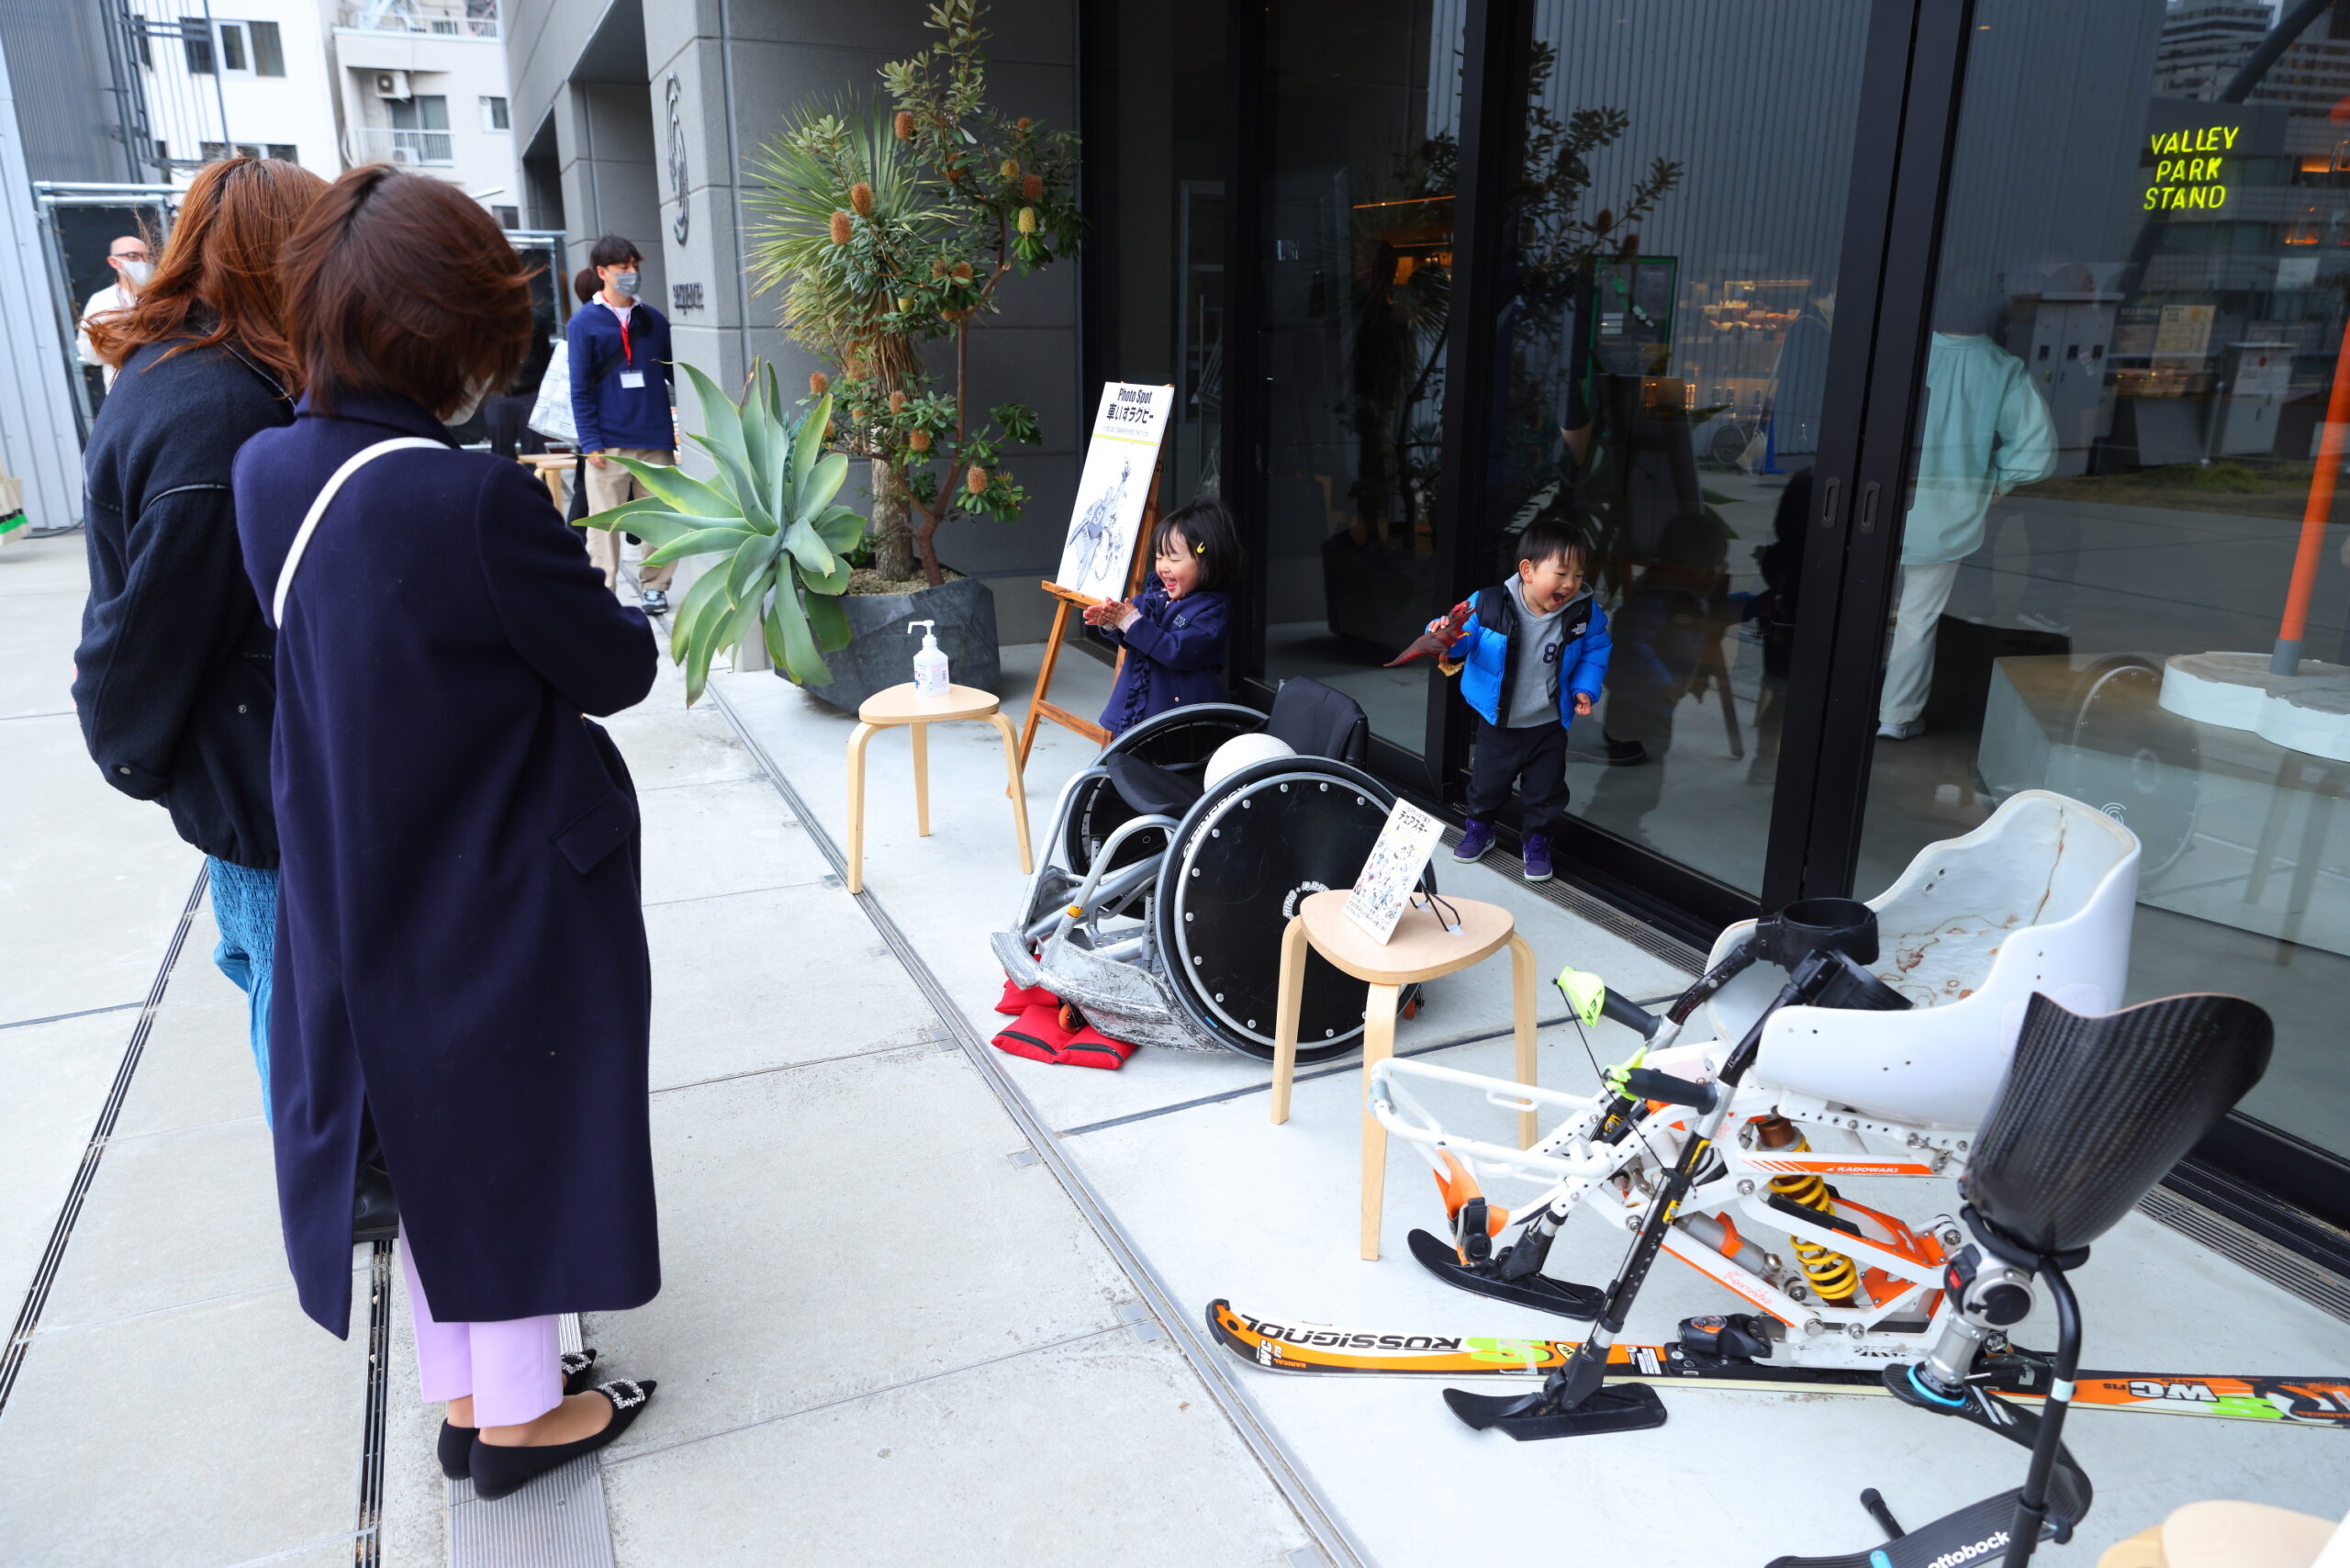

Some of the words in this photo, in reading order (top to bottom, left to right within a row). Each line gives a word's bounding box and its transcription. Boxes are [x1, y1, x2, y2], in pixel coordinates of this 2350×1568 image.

[2151, 126, 2240, 155] VALLEY
[2155, 156, 2223, 183] PARK
[2143, 185, 2227, 210] STAND
[1117, 387, 1136, 403] Photo
[1136, 389, 1153, 404] Spot
[1106, 403, 1154, 424] 車いすラグビー
[1542, 643, 1557, 664] 8
[1398, 810, 1428, 834] チェアスキー
[1240, 1314, 1463, 1351] ROSSIGNOL
[1272, 1358, 1307, 1369] RADICAL
[2102, 1383, 2126, 1391] FIS
[2128, 1380, 2220, 1403] WC
